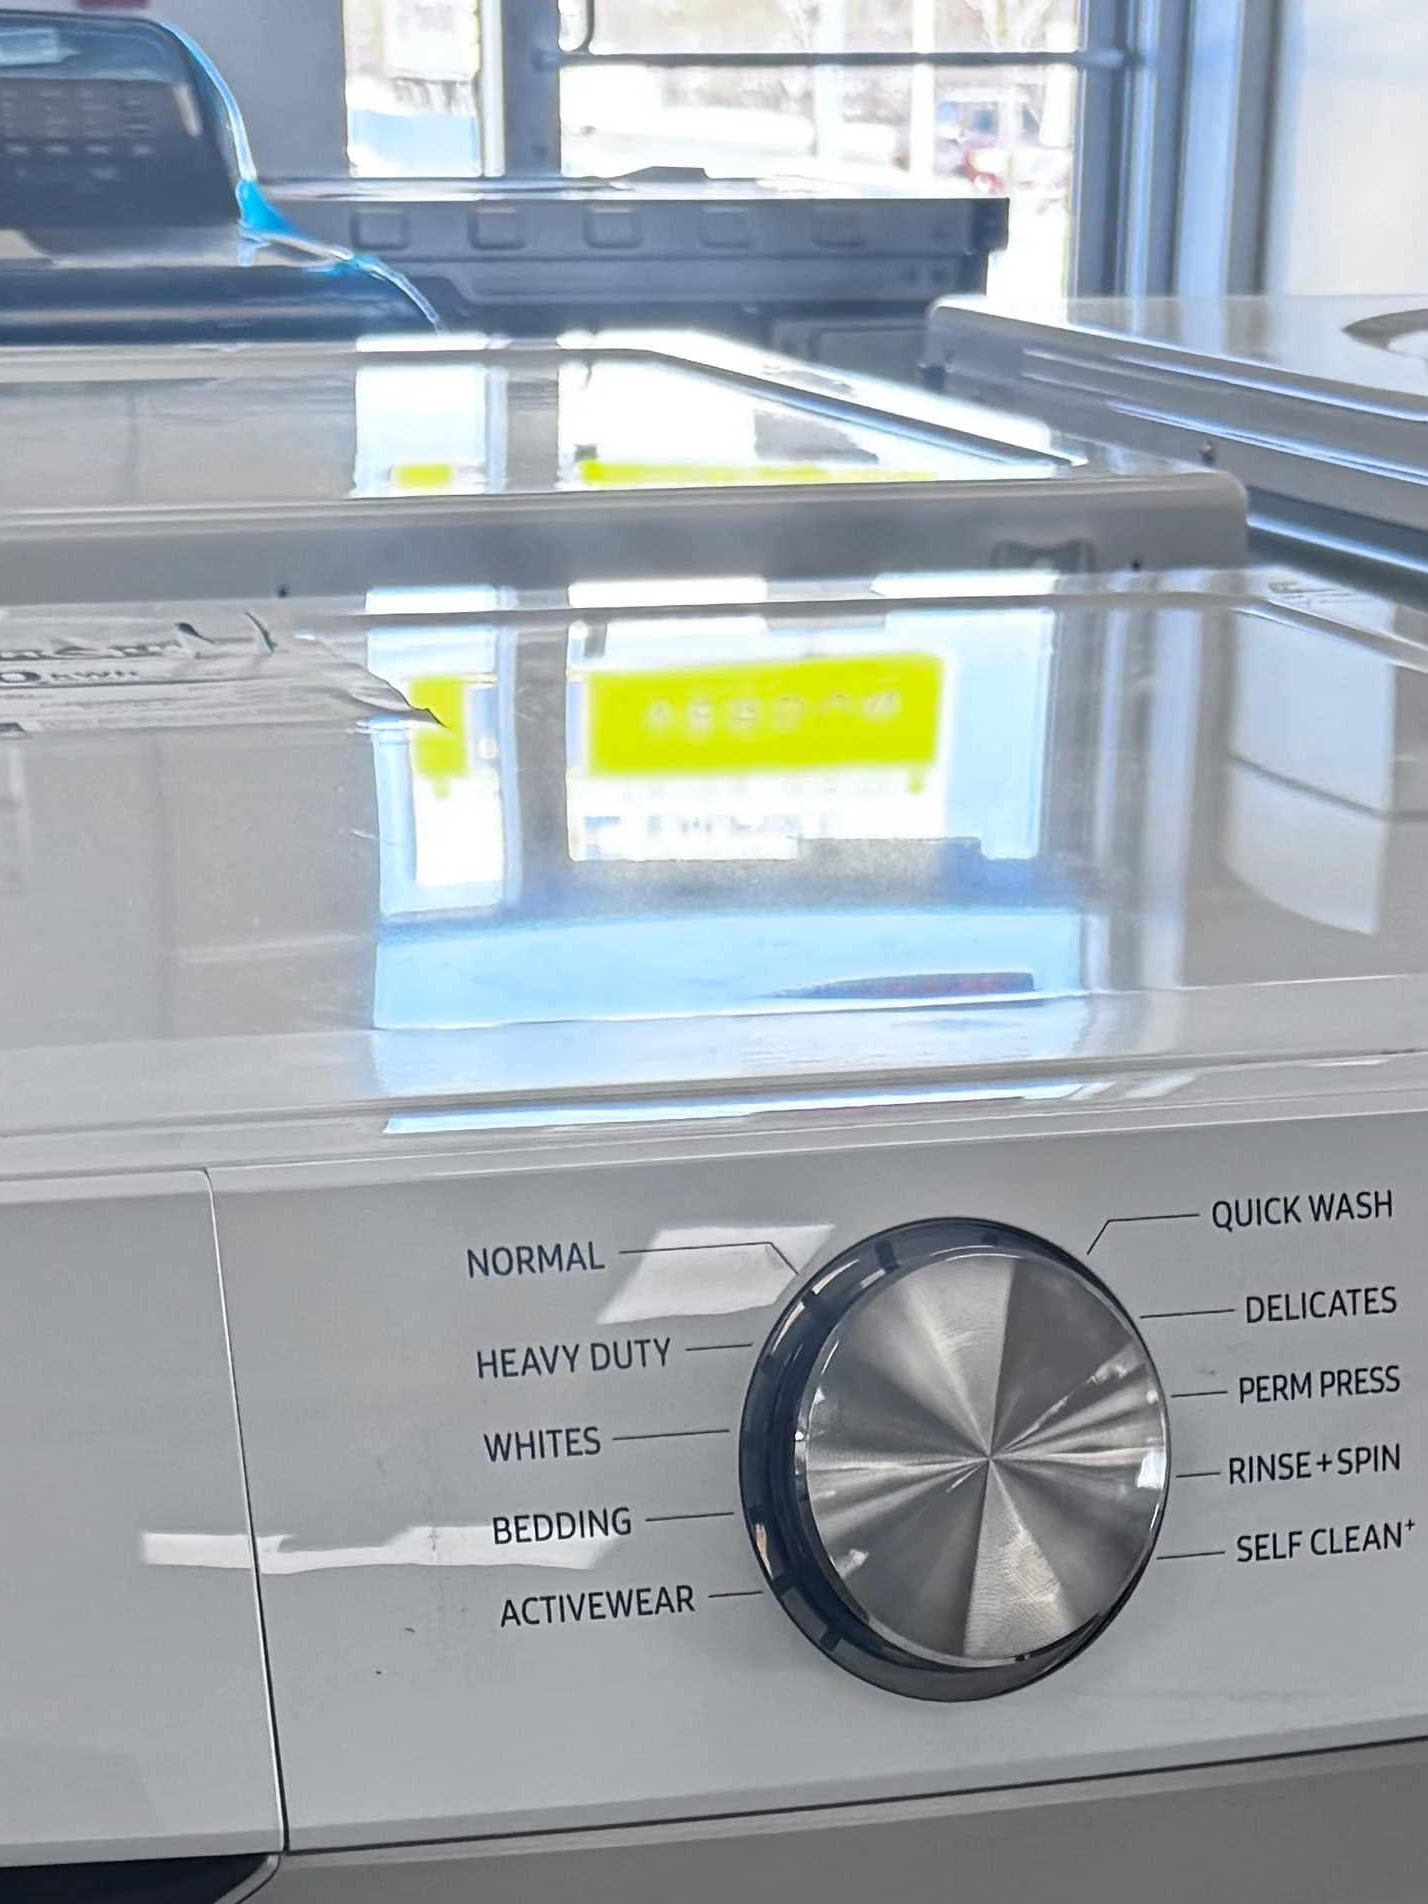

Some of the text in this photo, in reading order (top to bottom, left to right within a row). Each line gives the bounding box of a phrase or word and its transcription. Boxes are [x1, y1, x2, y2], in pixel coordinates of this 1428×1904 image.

[1212, 1189, 1393, 1233] QUICK WASH
[466, 1240, 606, 1279] NORMAL
[1246, 1285, 1398, 1324] DELICATES
[476, 1336, 671, 1379] HEAVY DUTY
[1239, 1364, 1401, 1405] PERM PRESS
[483, 1426, 601, 1463] WHITES
[492, 1506, 632, 1545] BEDDING
[1236, 1530, 1303, 1563] SELF
[500, 1584, 696, 1628] ACTIVEWEAR
